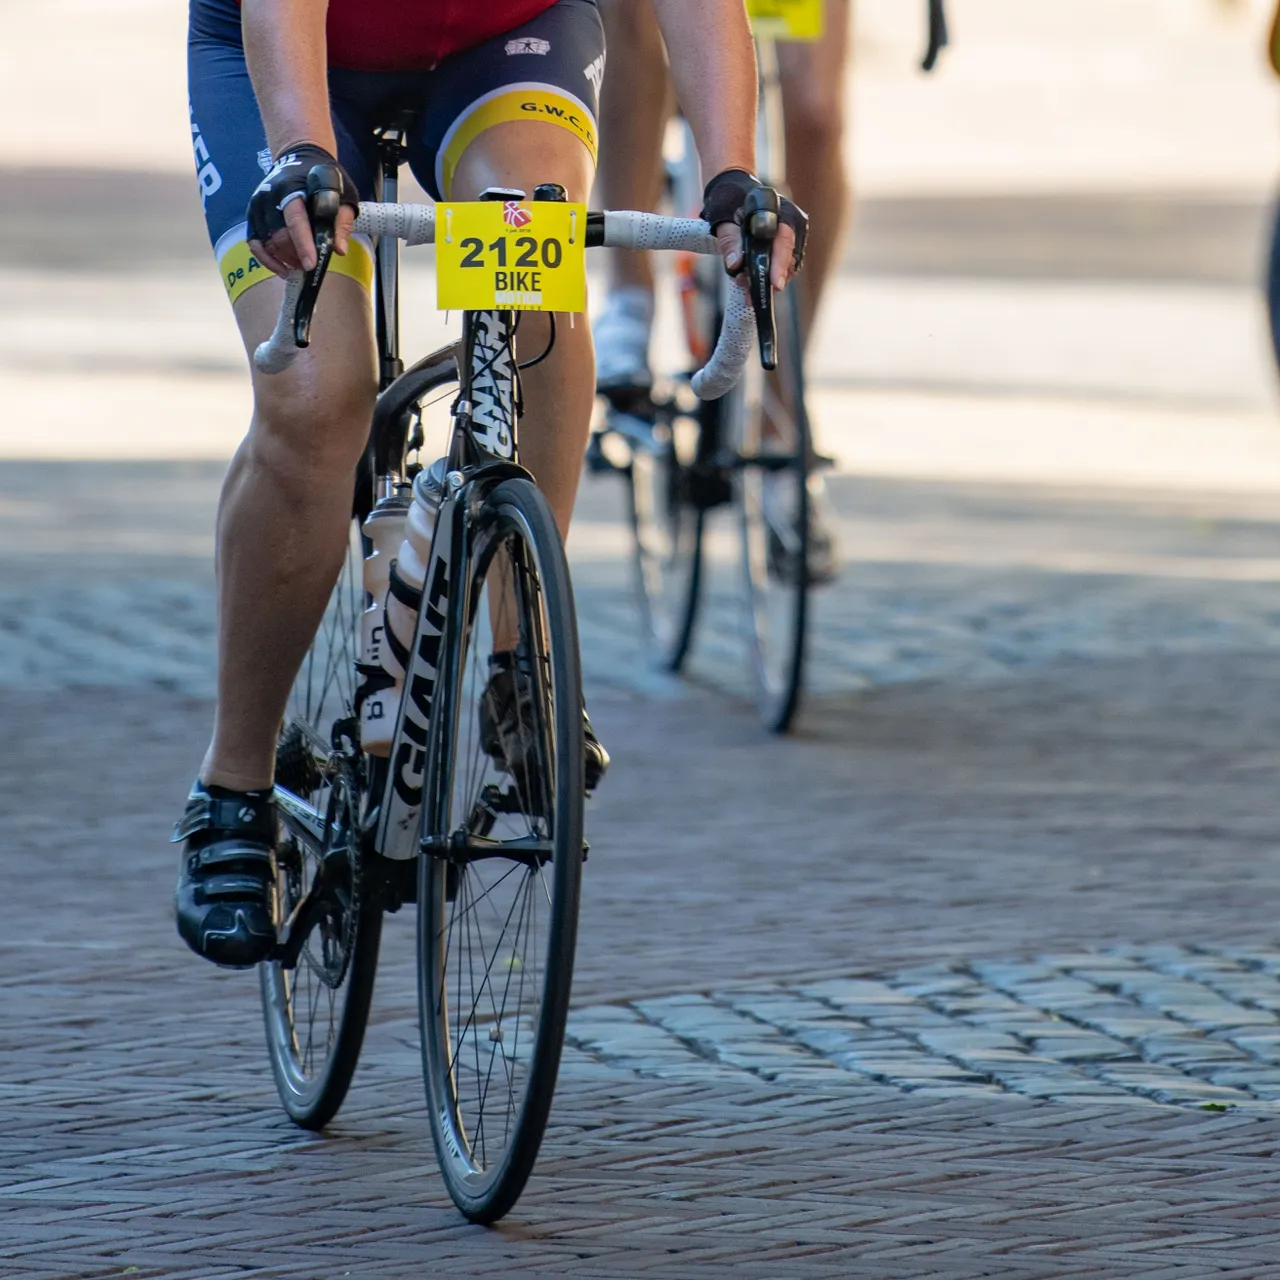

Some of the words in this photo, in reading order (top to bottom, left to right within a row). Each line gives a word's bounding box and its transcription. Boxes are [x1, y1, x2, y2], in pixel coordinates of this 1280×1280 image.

[460, 236, 562, 269] 2120
[228, 268, 244, 288] De
[495, 271, 542, 292] BIKE
[495, 291, 543, 305] MOTION
[394, 555, 448, 807] GIANT
